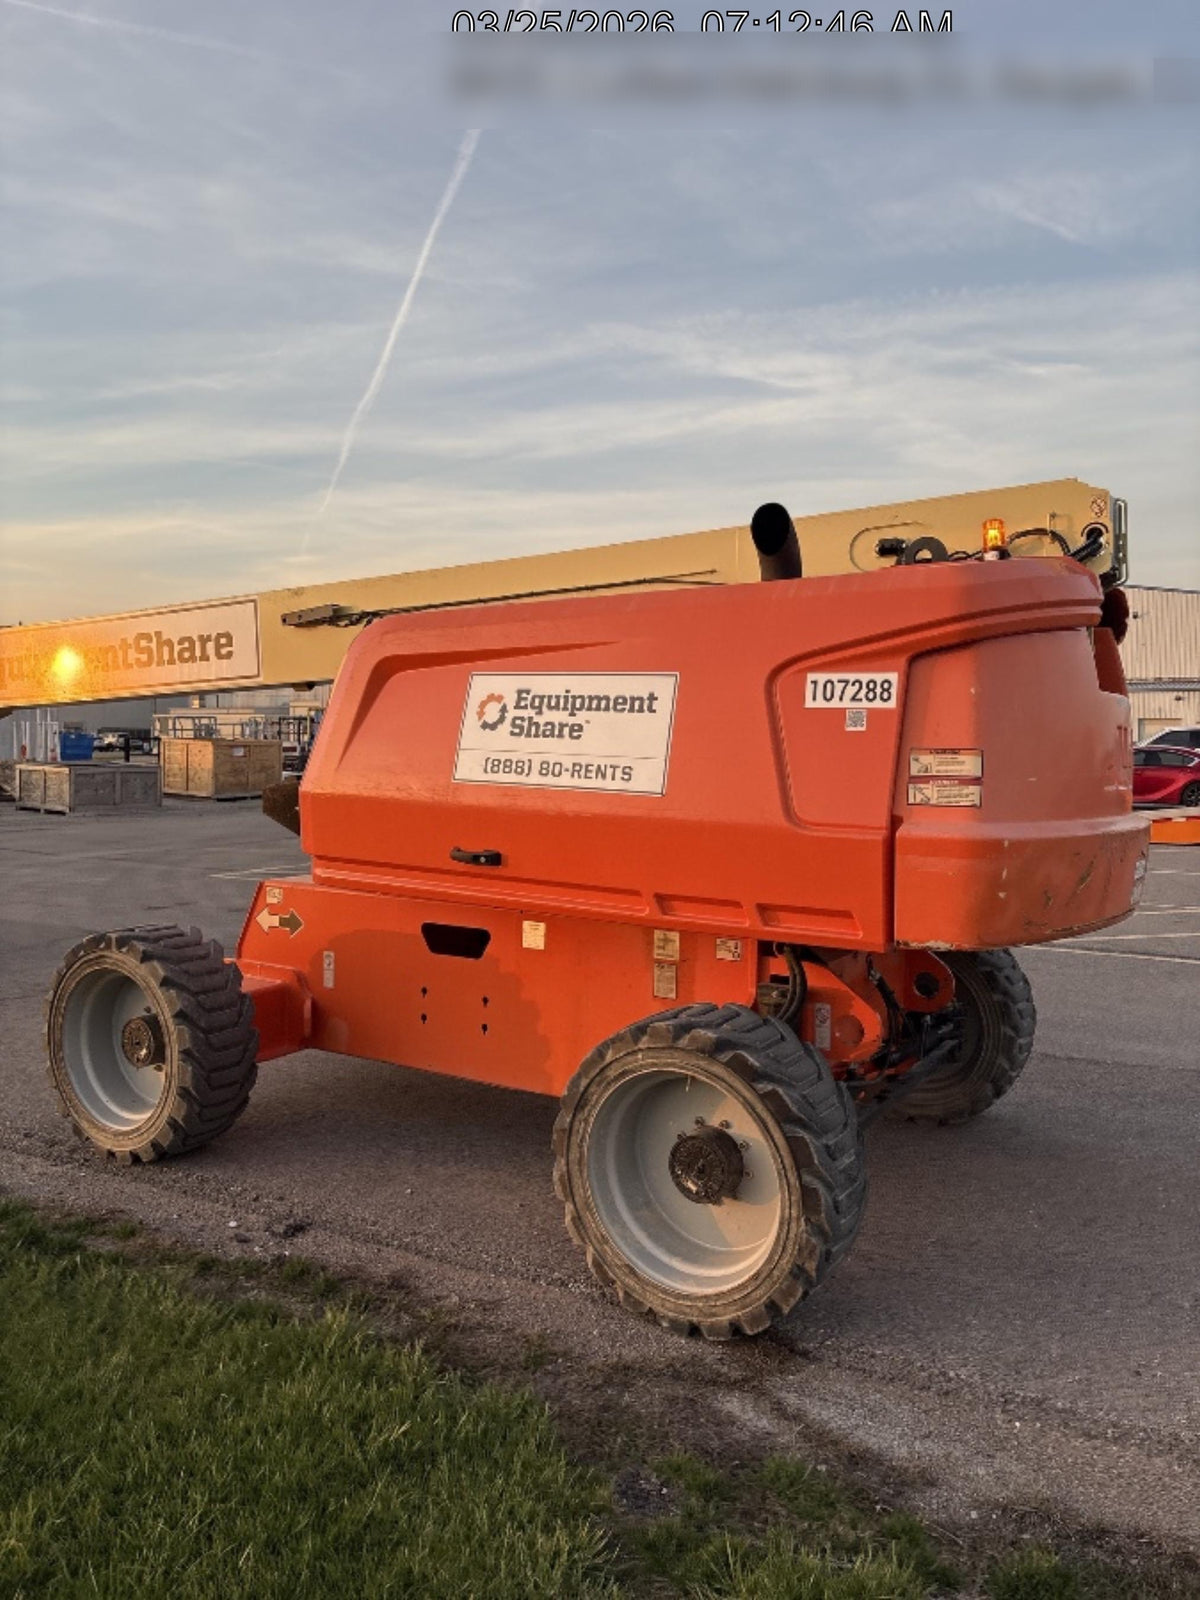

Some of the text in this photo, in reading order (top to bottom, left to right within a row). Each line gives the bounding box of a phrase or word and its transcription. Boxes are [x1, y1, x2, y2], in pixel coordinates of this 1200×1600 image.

[513, 688, 658, 717] Equipment
[810, 679, 893, 703] 107288
[509, 715, 584, 740] Share
[483, 756, 634, 782] (888) 80-RENTS
